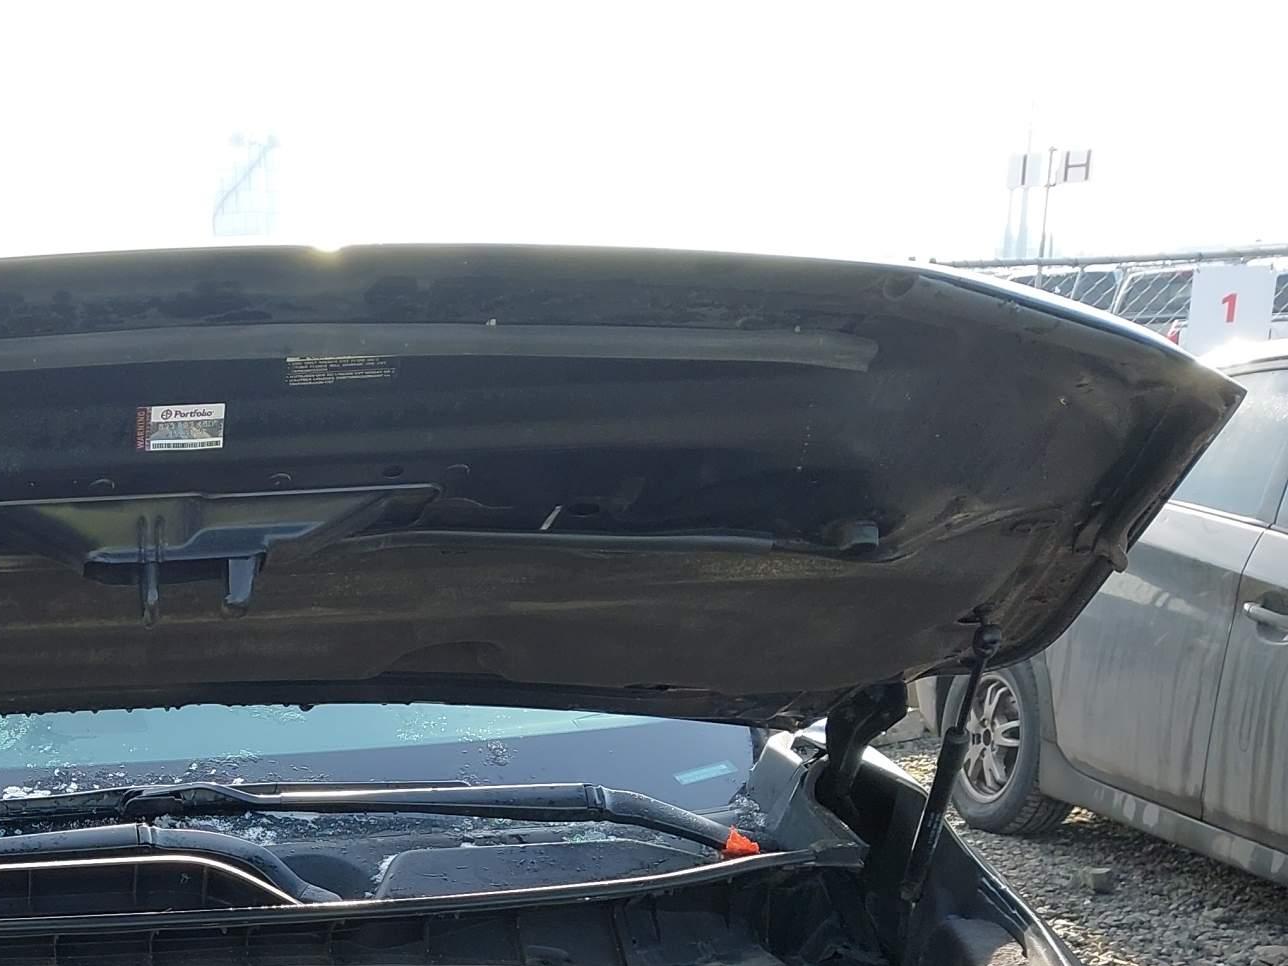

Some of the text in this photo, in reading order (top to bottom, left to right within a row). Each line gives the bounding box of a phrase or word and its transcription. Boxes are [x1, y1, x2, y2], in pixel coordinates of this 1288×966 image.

[1063, 148, 1092, 182] H
[1221, 292, 1238, 324] 1
[173, 408, 214, 419] Portfolio
